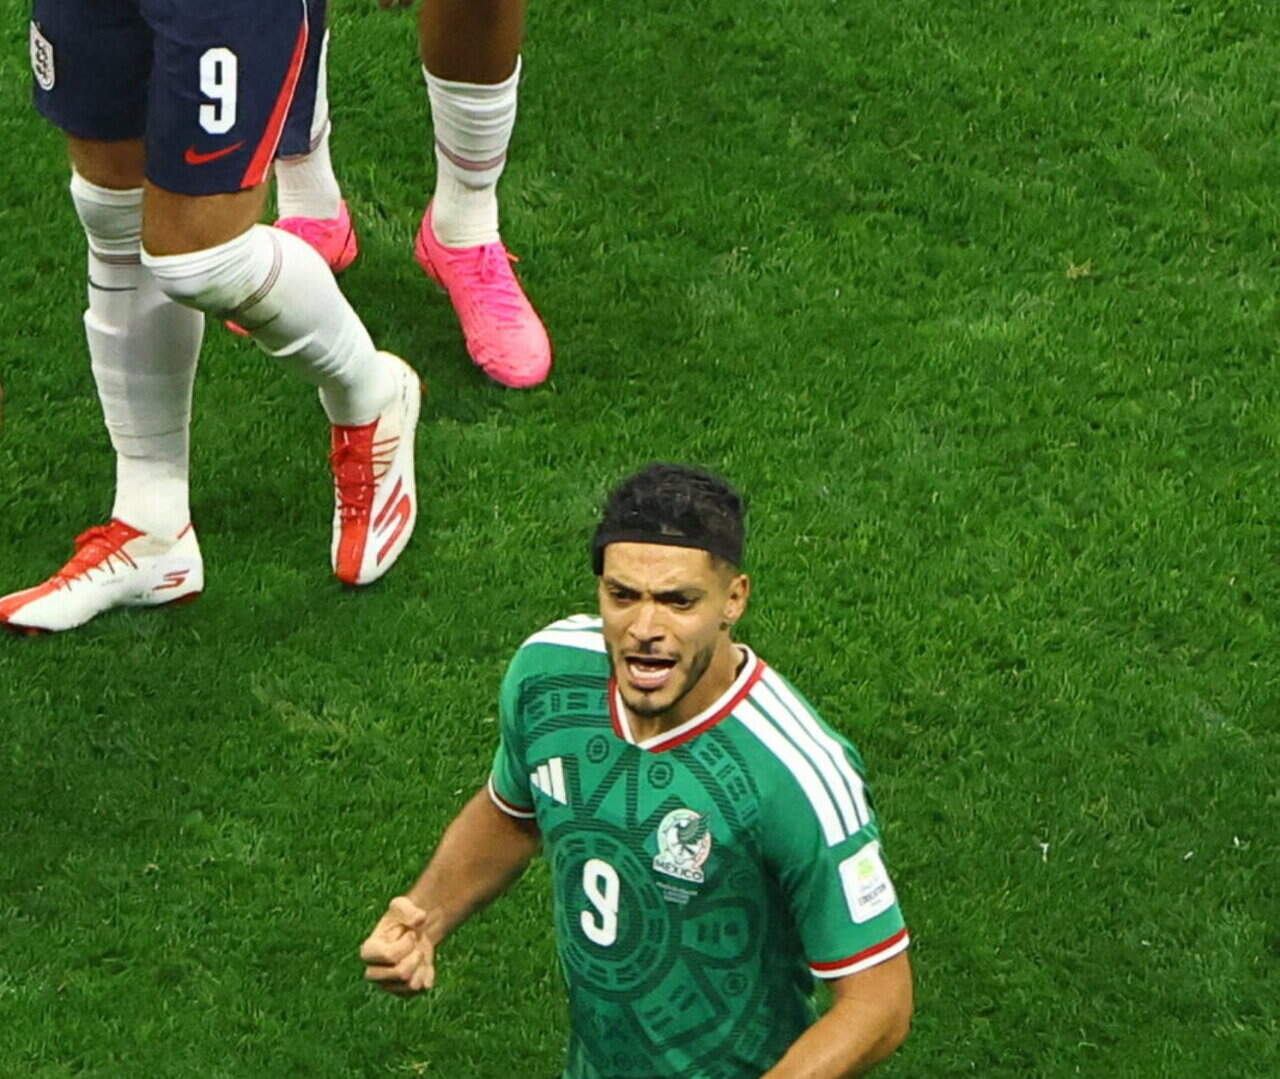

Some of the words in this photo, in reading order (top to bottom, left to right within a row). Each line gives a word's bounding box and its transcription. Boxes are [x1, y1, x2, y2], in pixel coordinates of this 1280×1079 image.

[199, 47, 238, 134] 9
[580, 858, 620, 947] 9
[654, 859, 702, 881] MEXICO
